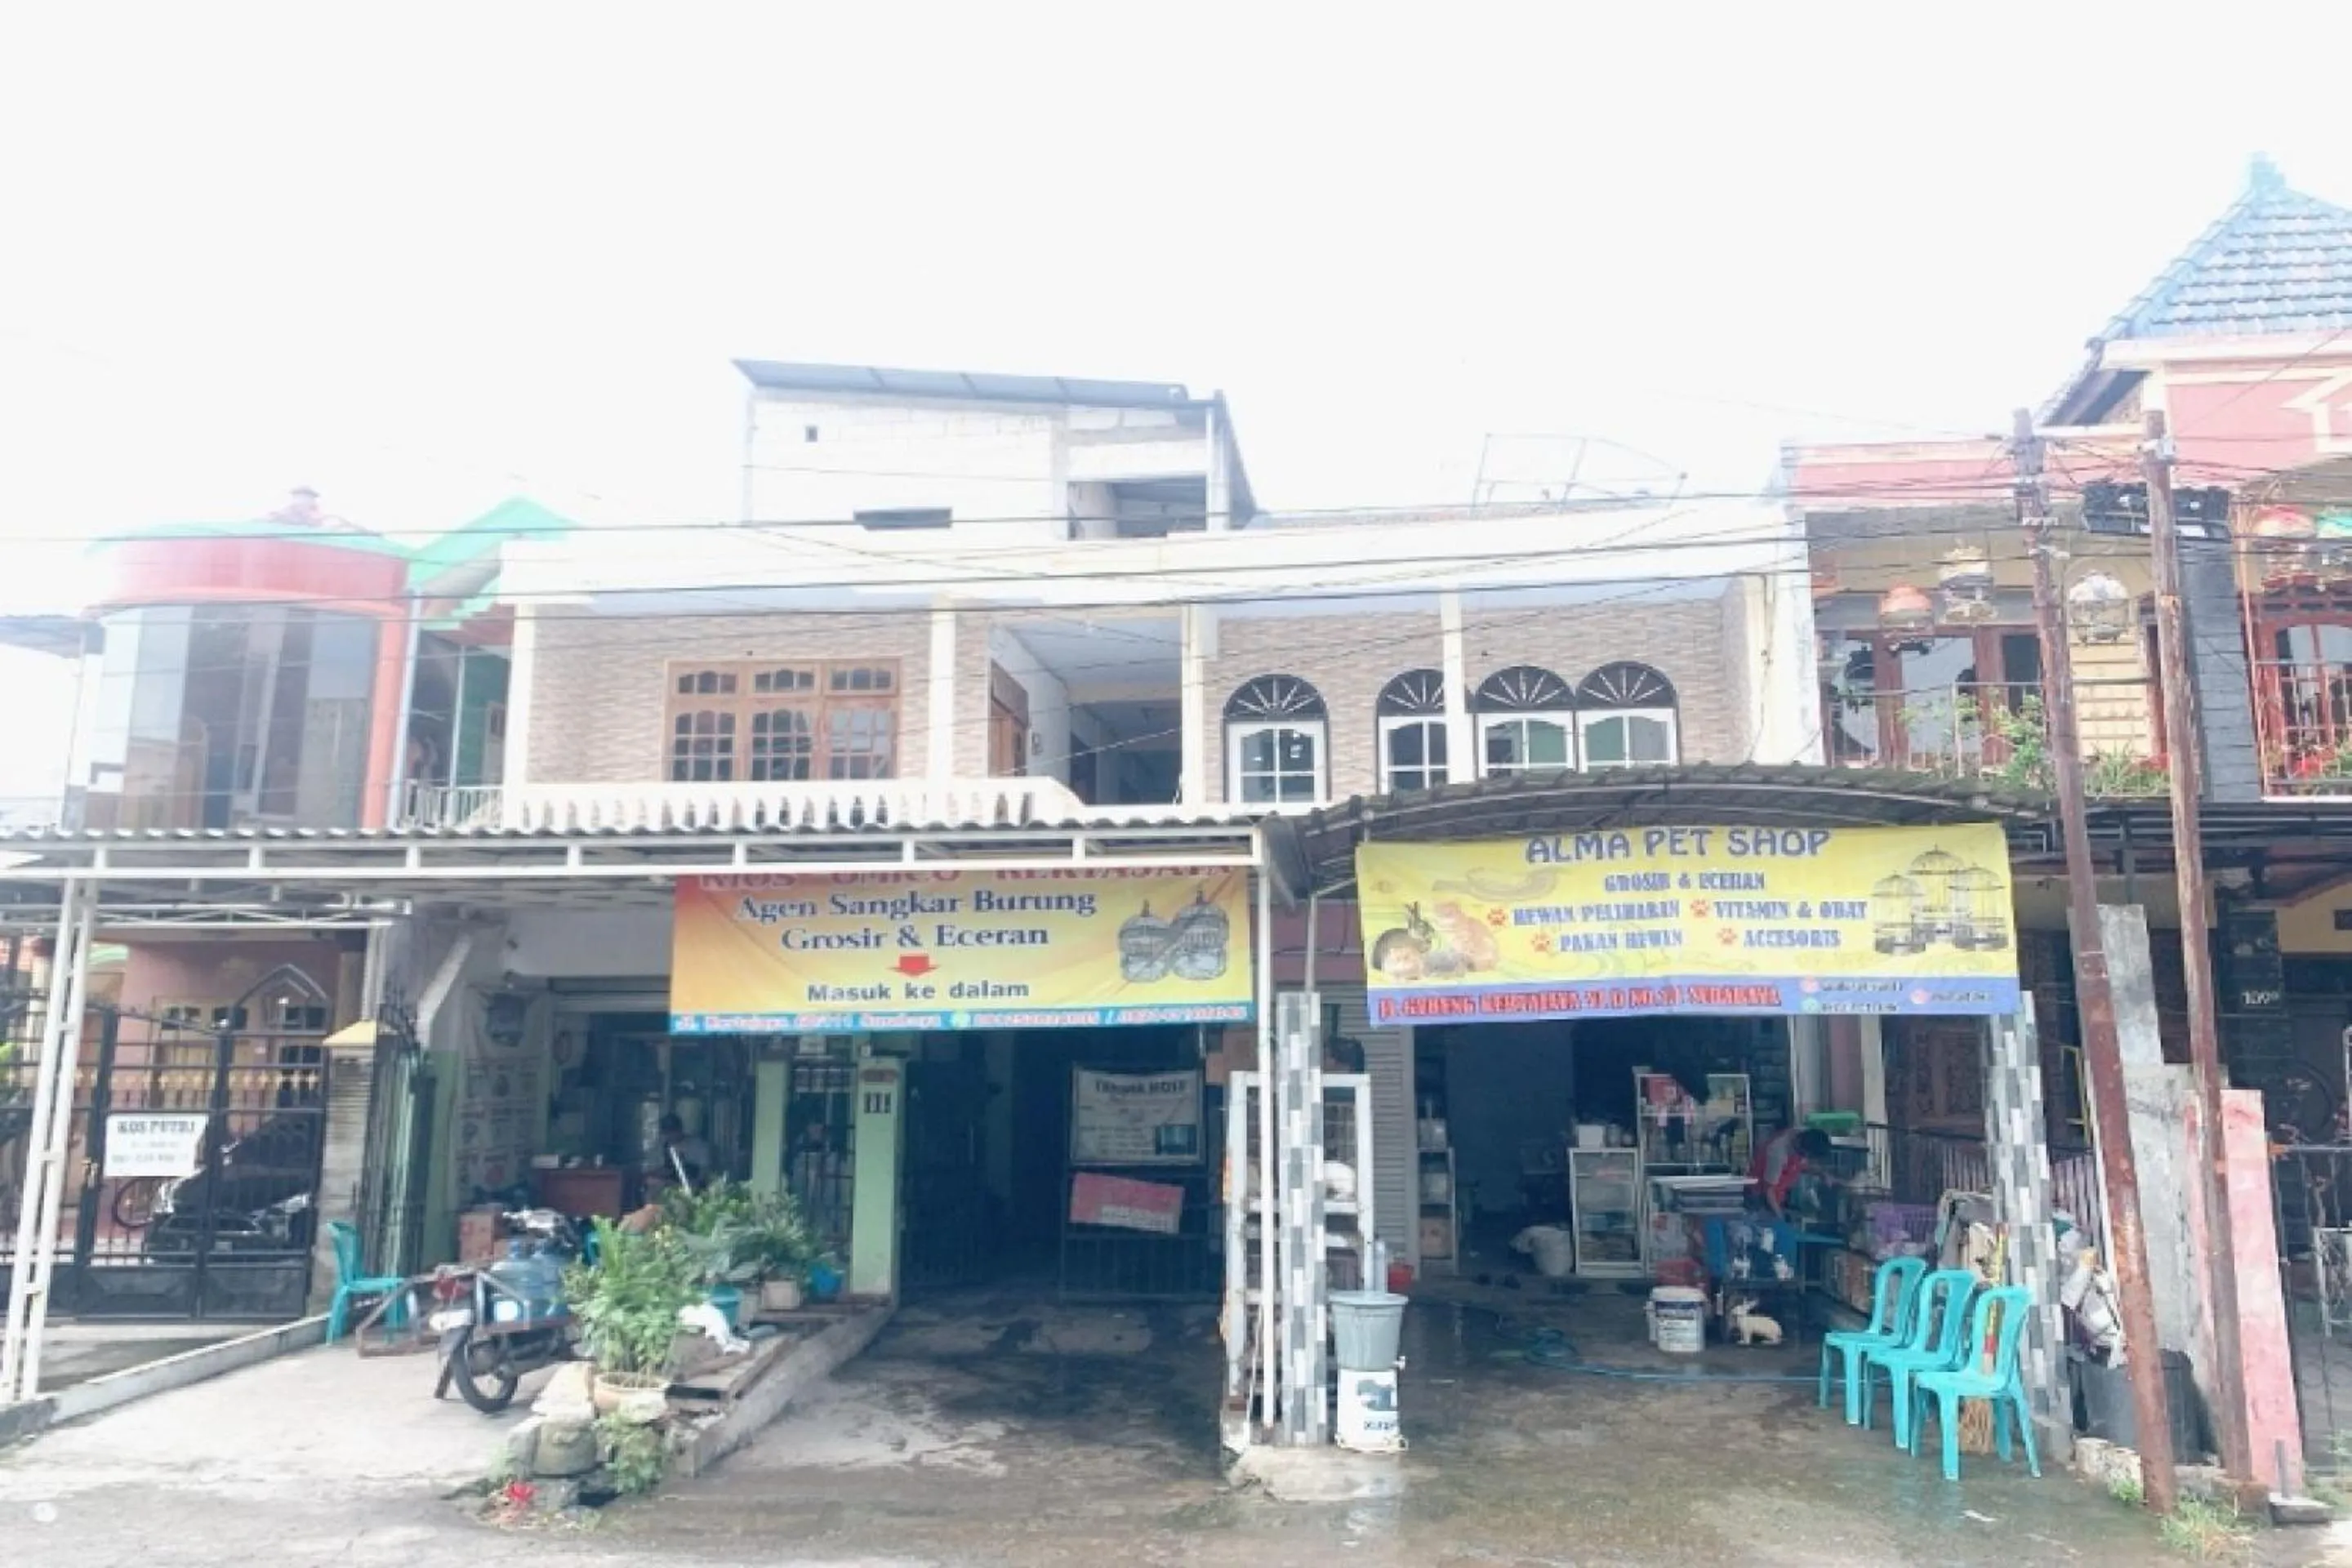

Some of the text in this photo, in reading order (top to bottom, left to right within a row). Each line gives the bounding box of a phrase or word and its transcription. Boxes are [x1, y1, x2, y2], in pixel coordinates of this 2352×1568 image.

[1526, 828, 1832, 863] ALMA PET SHOP
[737, 890, 1096, 923] Agen Sangkar Burung
[782, 924, 1049, 949] Grosir & Eceran
[808, 980, 1029, 1001] Masuk ke dalam
